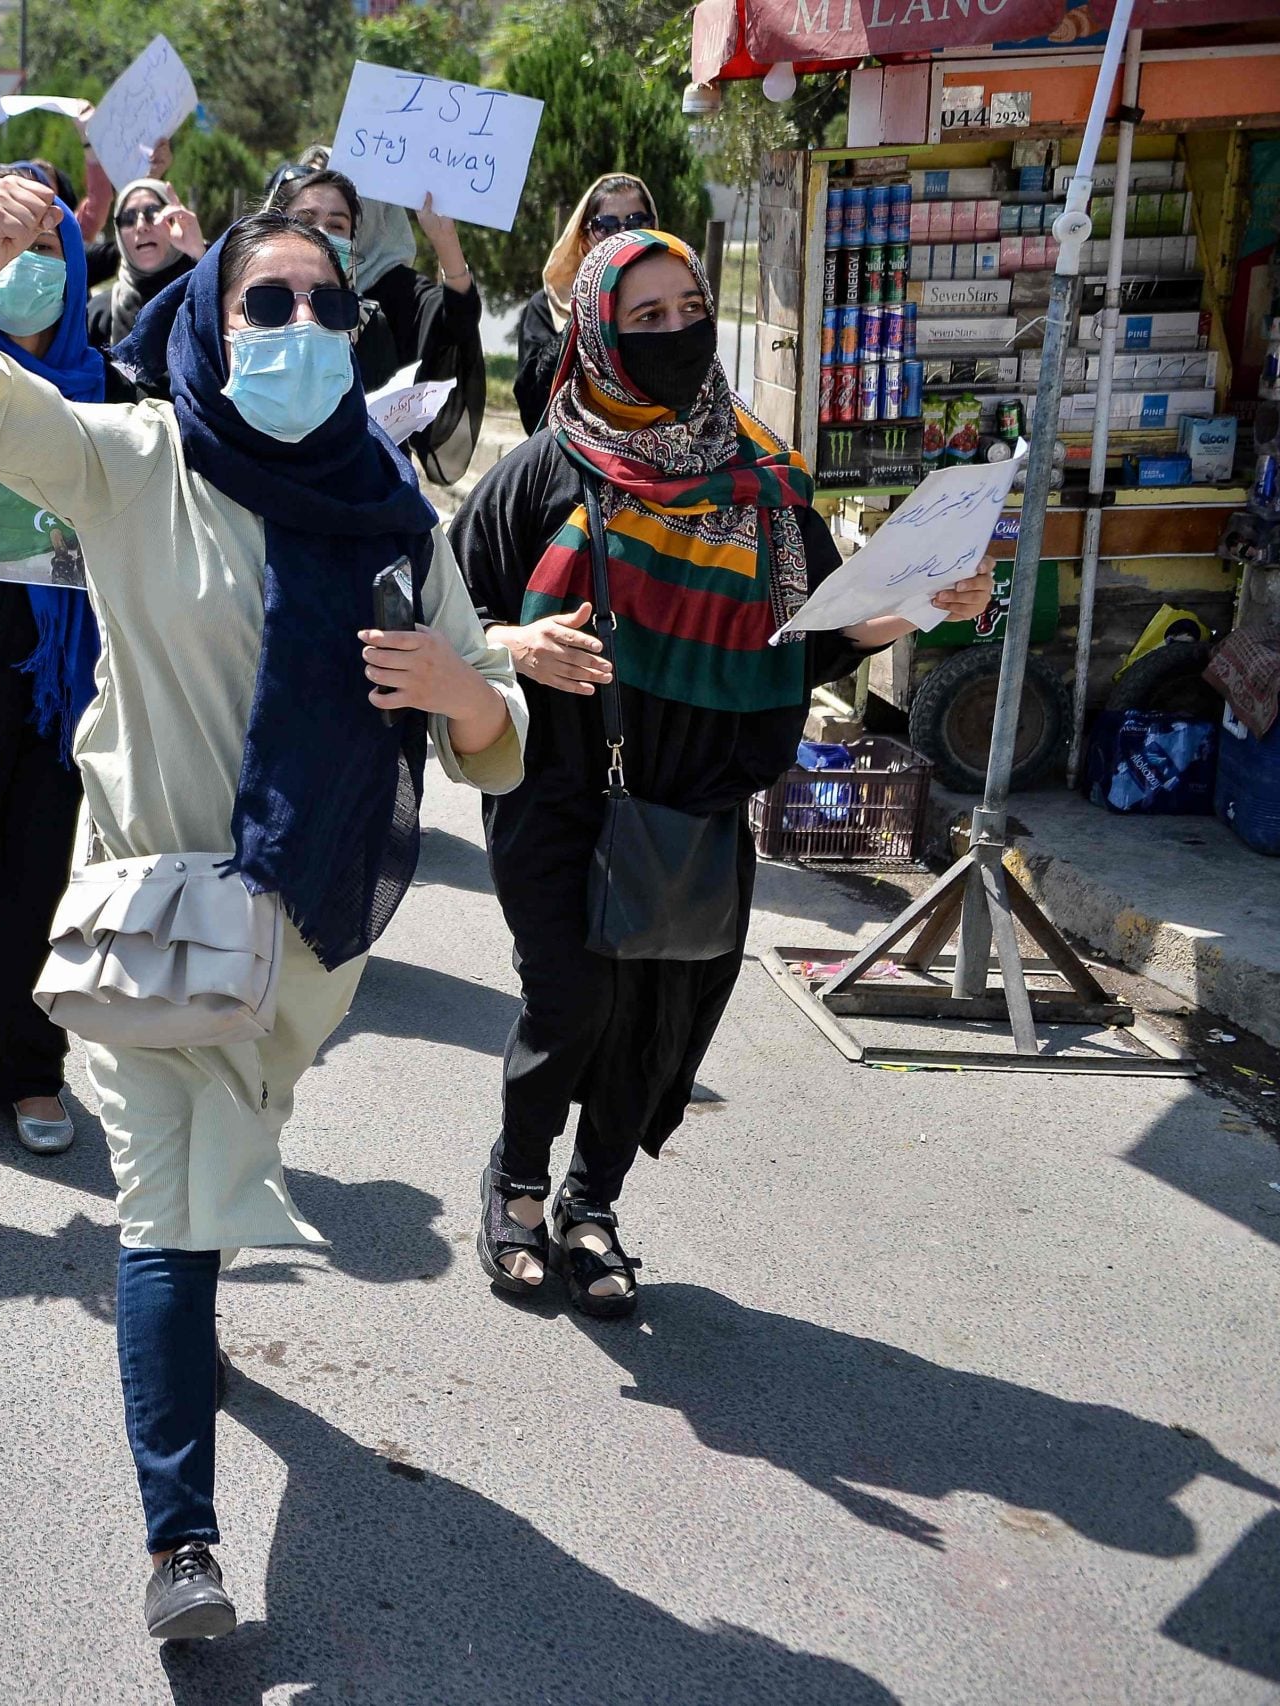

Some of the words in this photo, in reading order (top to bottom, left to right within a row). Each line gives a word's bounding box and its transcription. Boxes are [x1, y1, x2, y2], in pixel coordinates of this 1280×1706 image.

[941, 108, 990, 129] 044
[995, 110, 1026, 125] 2929
[350, 128, 407, 165] Stay
[428, 146, 496, 194] away
[926, 184, 946, 193] PINE
[824, 256, 836, 302] ENERGY
[847, 255, 859, 300] ENERGY
[1128, 330, 1148, 338] PINE
[1143, 408, 1165, 416] PINE
[1131, 754, 1160, 791] Alokozay
